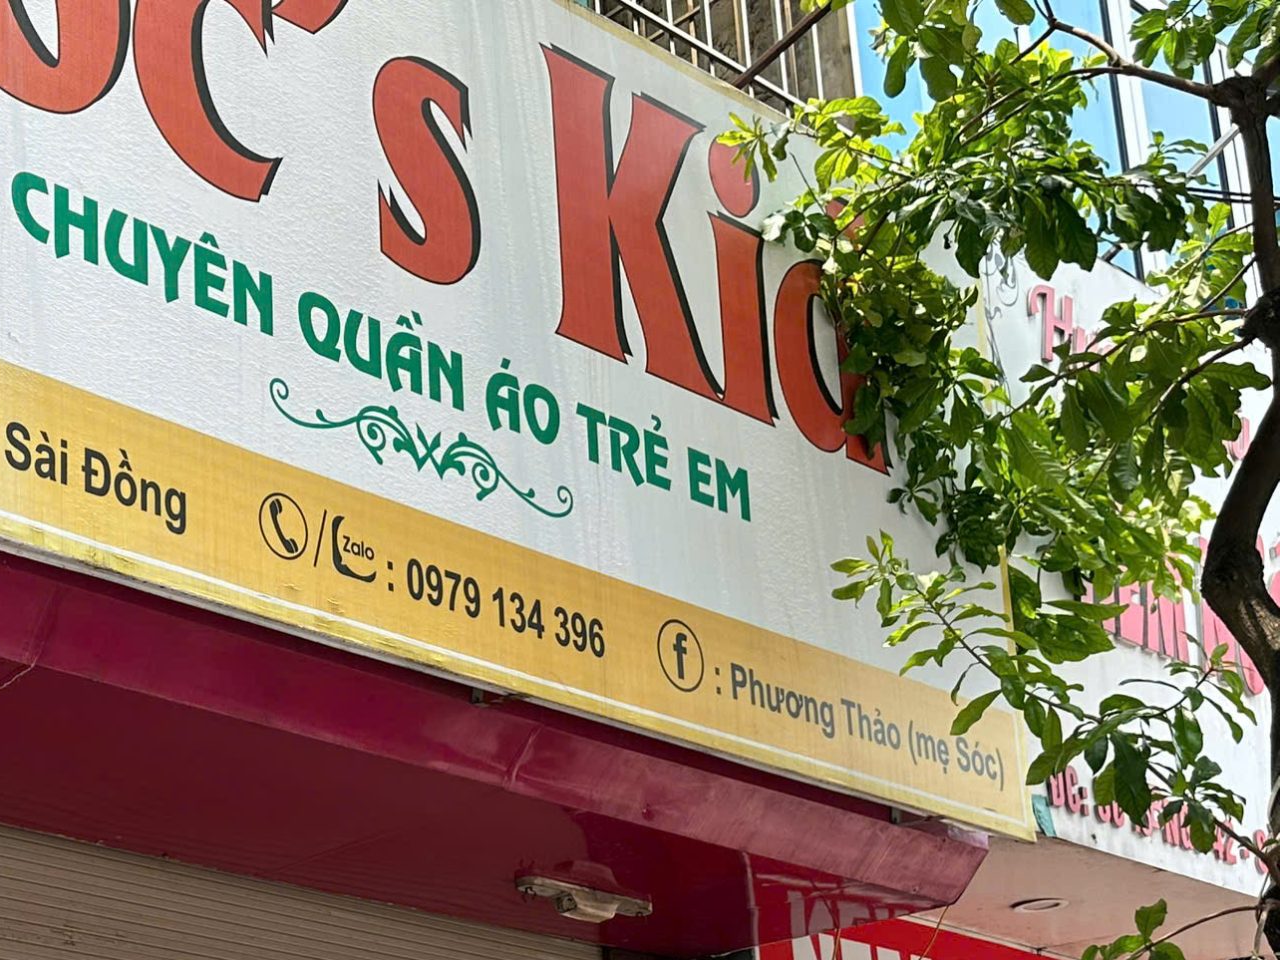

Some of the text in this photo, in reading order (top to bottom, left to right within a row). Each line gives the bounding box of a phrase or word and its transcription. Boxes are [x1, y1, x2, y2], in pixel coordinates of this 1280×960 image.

[11, 170, 752, 523] CHUYÊN QUẦN ÁO TRẺ EM
[4, 422, 69, 486] Sài
[81, 448, 187, 534] Đồng
[342, 534, 375, 561] Zalo
[406, 557, 481, 620] 0979
[491, 586, 545, 642] 134
[553, 604, 606, 660] 396
[730, 663, 835, 739] Phương
[840, 697, 902, 752] Thảo
[908, 718, 949, 778] (mẹ
[956, 730, 1005, 791] Sóc)
